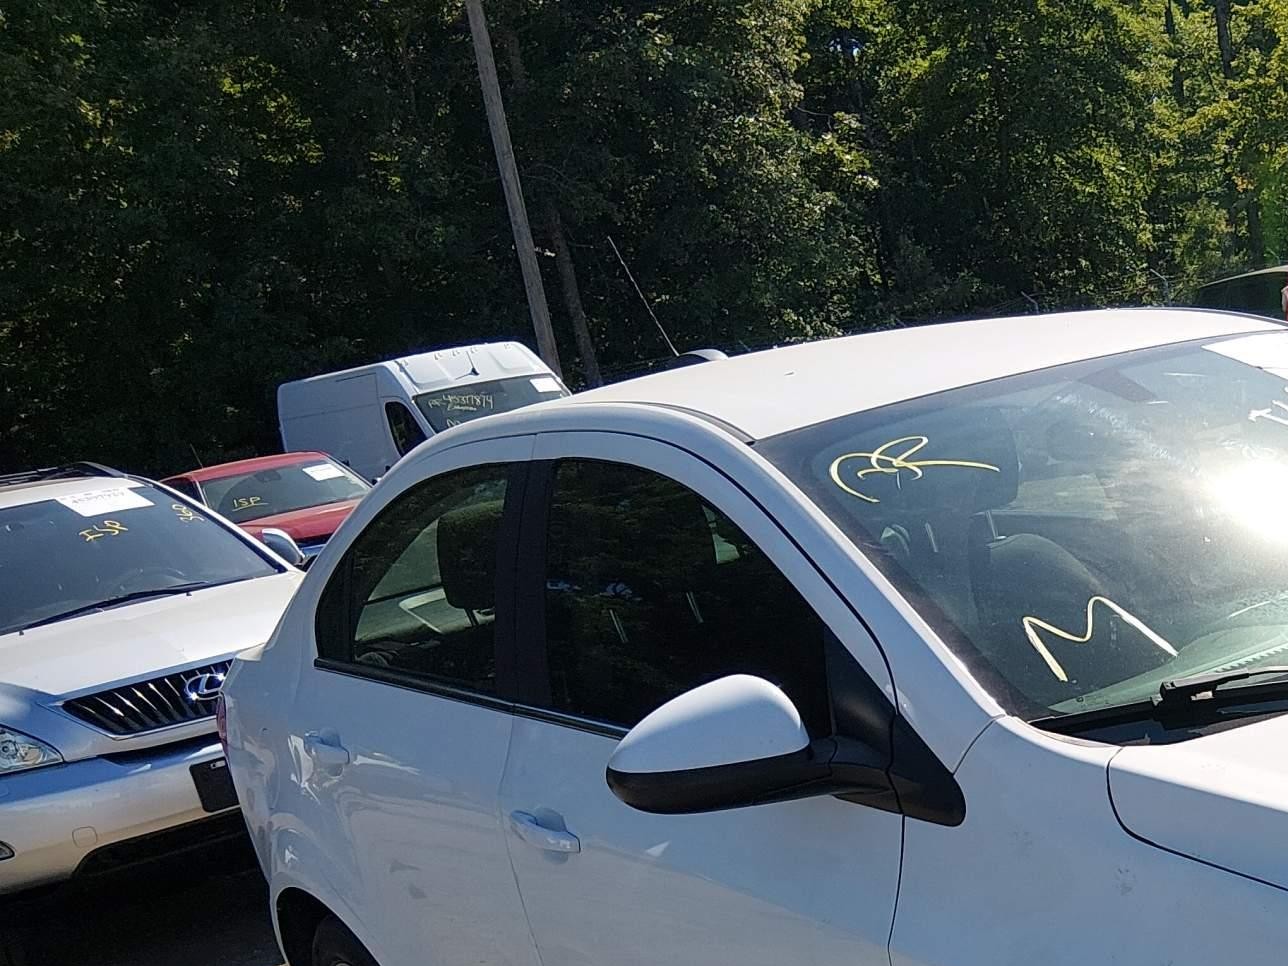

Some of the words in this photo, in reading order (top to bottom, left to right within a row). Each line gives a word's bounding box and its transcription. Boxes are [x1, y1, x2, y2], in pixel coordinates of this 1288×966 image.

[233, 496, 261, 508] ISP
[79, 520, 128, 542] ISP
[1023, 596, 1179, 682] M
